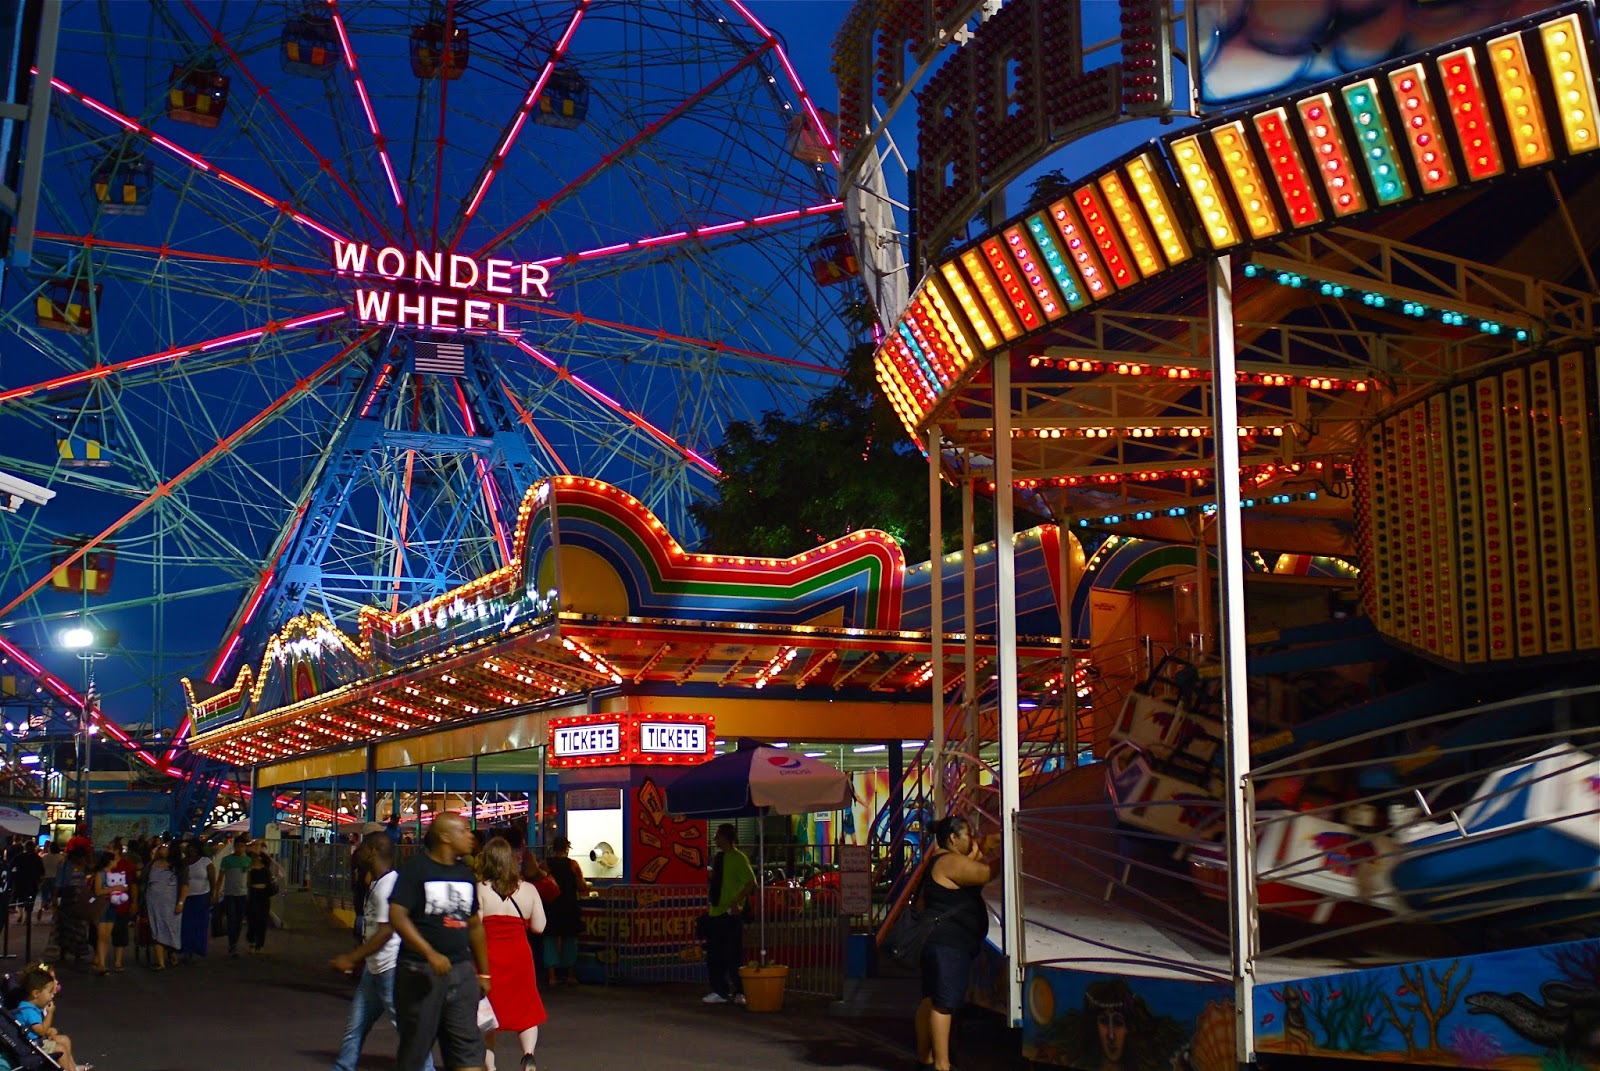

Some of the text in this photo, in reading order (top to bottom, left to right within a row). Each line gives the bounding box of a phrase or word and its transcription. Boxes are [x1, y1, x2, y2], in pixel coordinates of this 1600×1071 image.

[333, 239, 552, 298] WONDER
[355, 288, 522, 337] WHEEL
[560, 728, 613, 752] TICKETS
[648, 728, 699, 749] TICKETS
[59, 811, 76, 819] TIC
[580, 914, 698, 938] KETS TICKET
